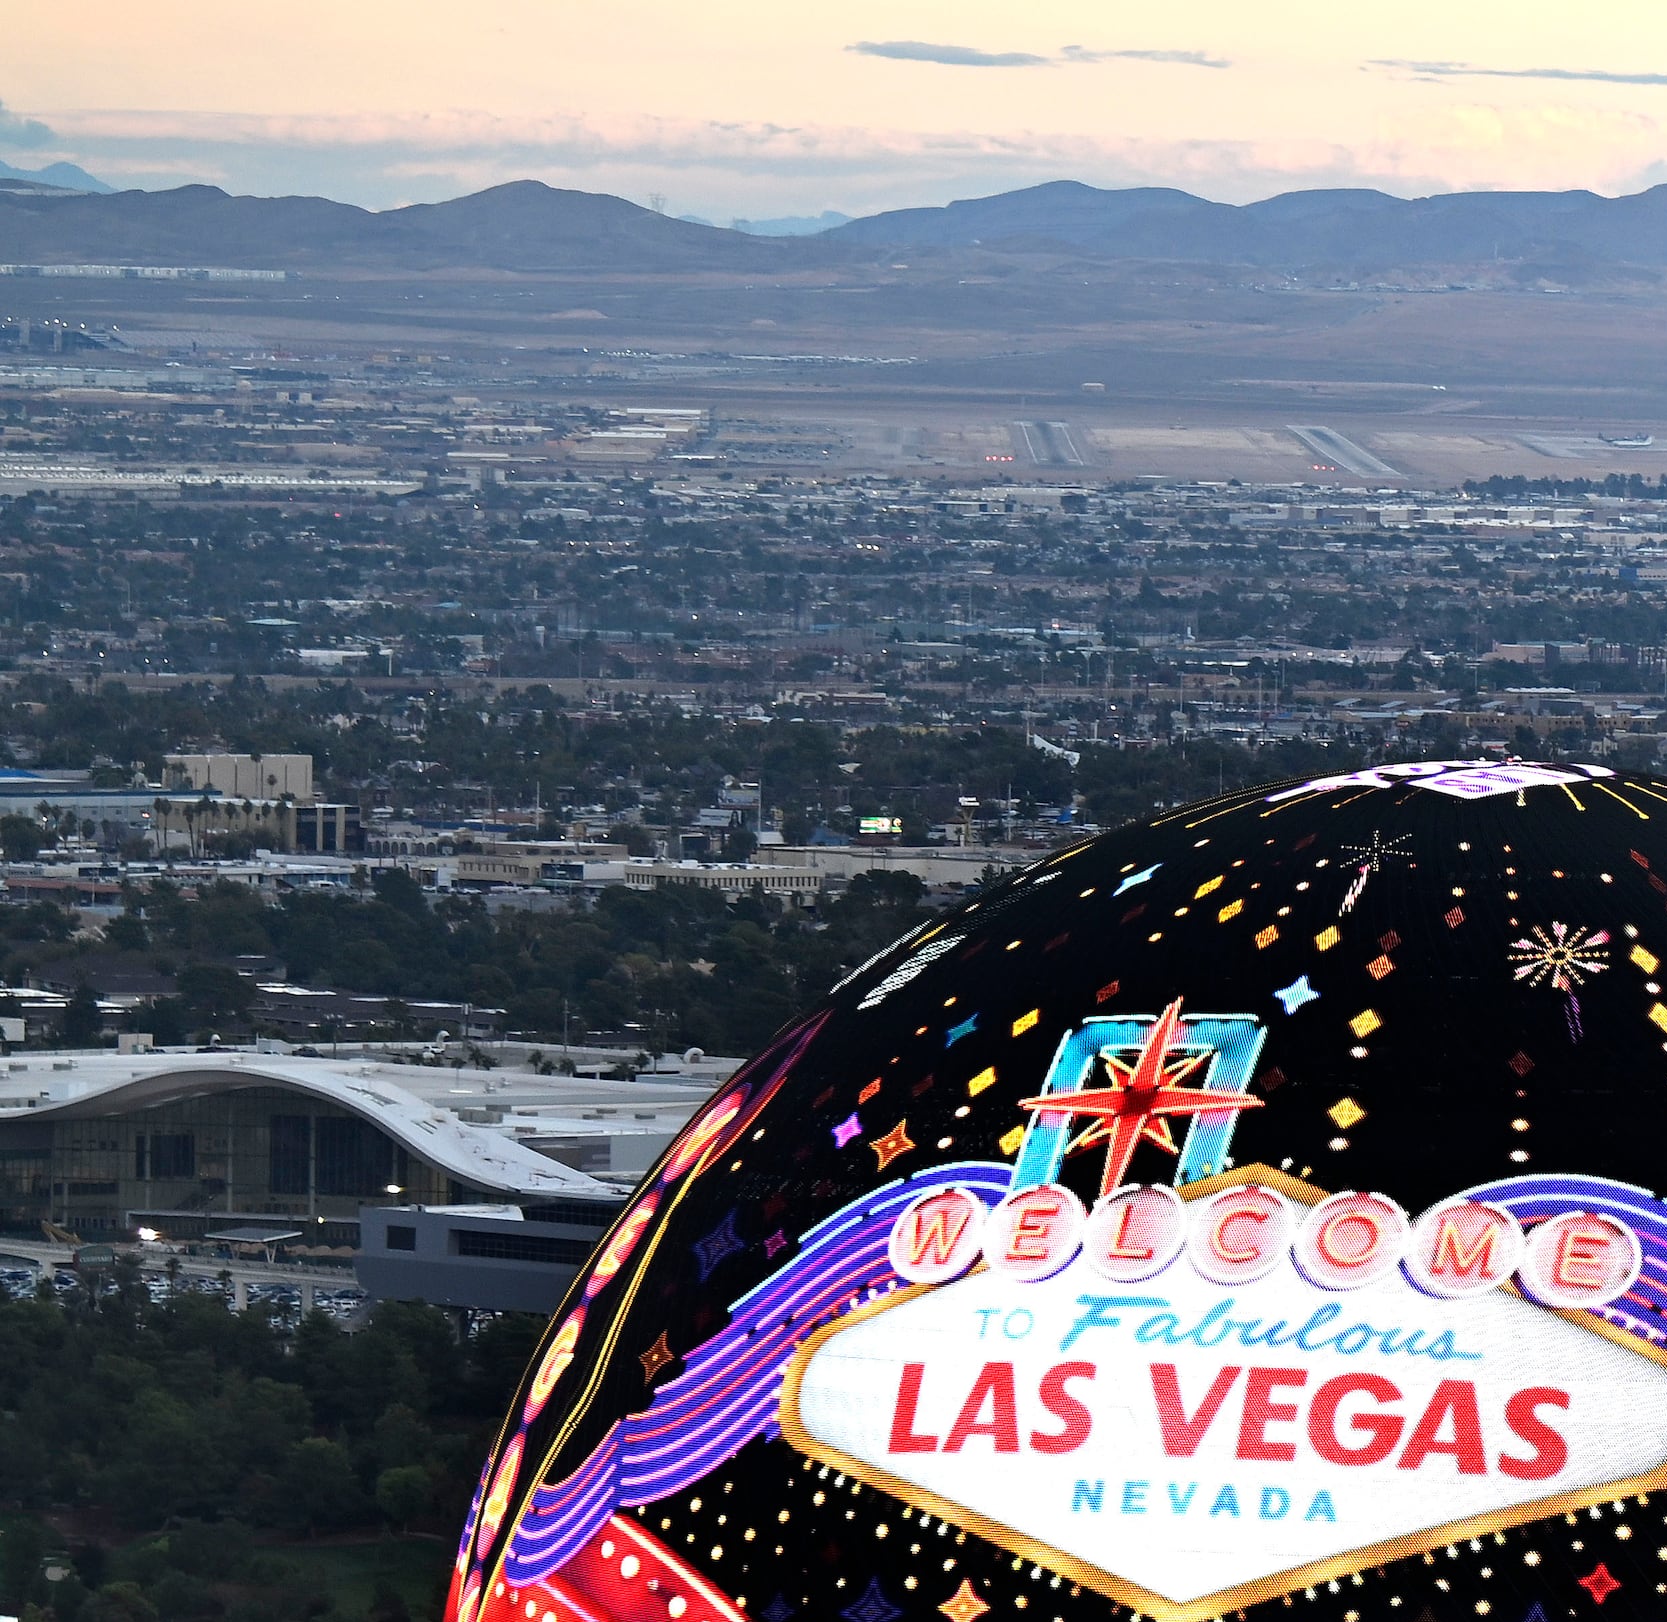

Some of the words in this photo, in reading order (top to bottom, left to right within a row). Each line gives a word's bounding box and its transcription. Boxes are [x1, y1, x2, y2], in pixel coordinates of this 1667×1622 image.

[902, 1202, 1614, 1291] WELCOME
[975, 1307, 1034, 1341] TO
[1061, 1294, 1484, 1362] Fabulous
[887, 1361, 1097, 1456] LAS
[1148, 1362, 1572, 1482] VEGAS
[1072, 1480, 1338, 1523] NEVADA
